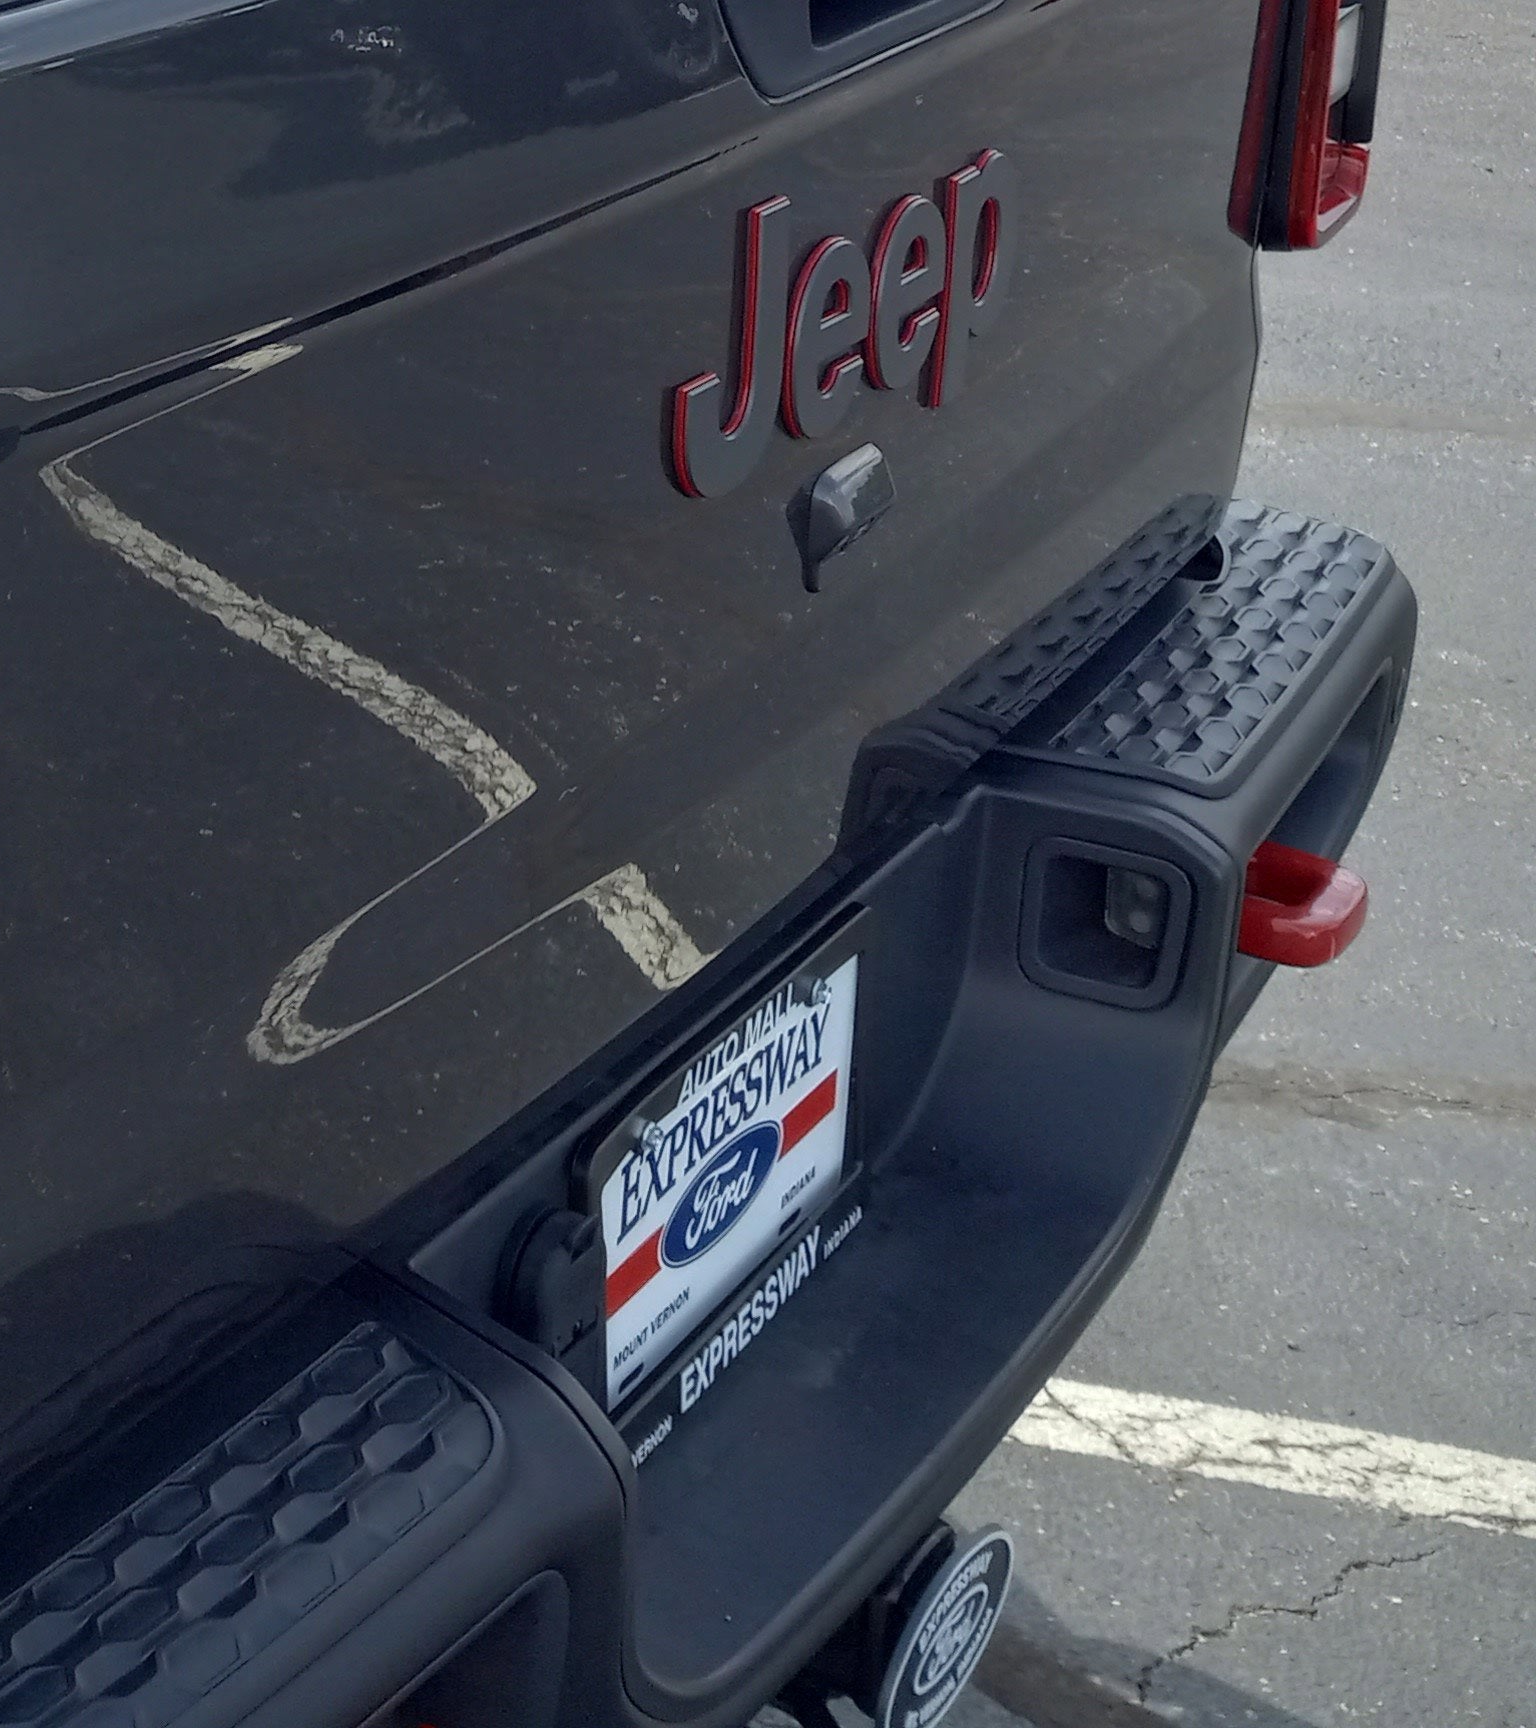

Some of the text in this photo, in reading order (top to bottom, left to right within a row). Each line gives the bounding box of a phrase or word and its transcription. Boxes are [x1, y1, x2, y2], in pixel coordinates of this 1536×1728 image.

[670, 148, 1016, 498] Jeep
[682, 982, 797, 1103] AUTO MALL
[616, 1001, 831, 1246] EXPRESSWAY
[685, 1147, 759, 1250] Ford
[780, 1165, 816, 1210] INDIANA
[612, 1285, 691, 1371] MOUNT VERNON
[630, 1205, 863, 1470] VERNON EXPRESSWAY INDIANA
